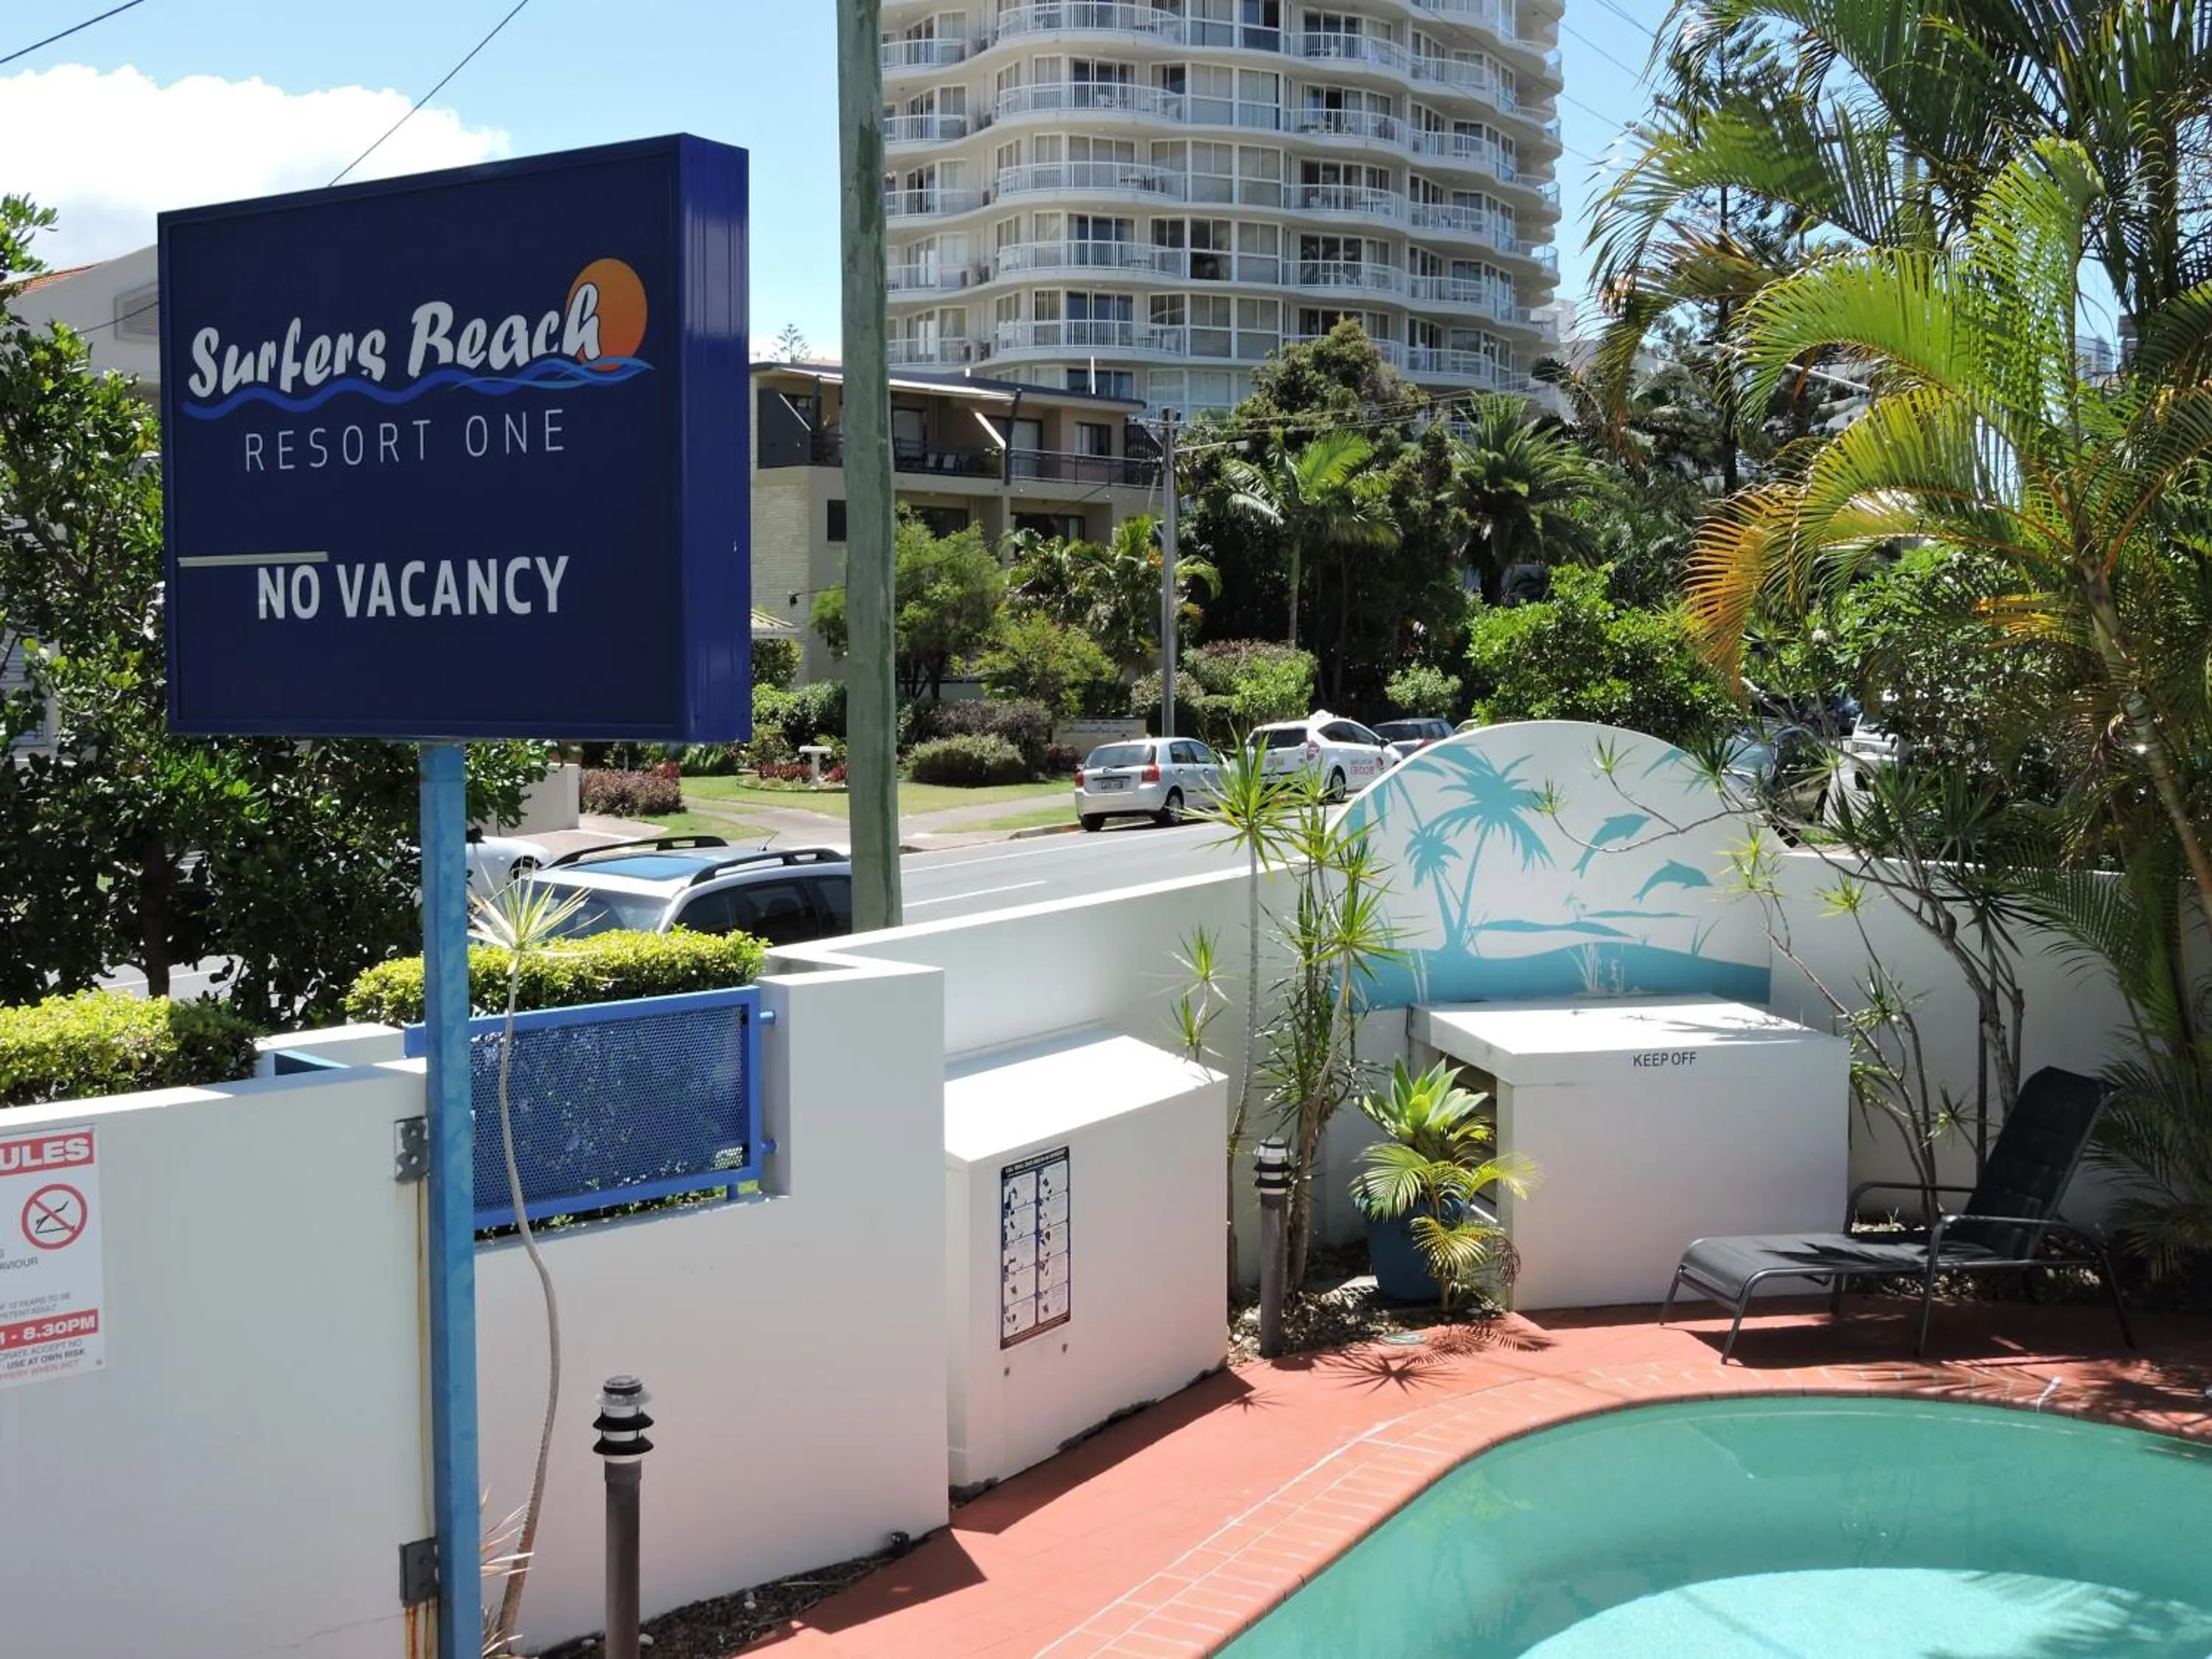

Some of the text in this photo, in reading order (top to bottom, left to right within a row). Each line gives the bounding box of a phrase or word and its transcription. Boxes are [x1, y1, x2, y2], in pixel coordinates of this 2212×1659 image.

[188, 282, 602, 397] Surfers Reach
[246, 409, 565, 472] RESORT ONE
[258, 555, 569, 619] NO VACANCY
[1632, 1051, 1697, 1068] KEEP OFF
[7, 1348, 86, 1370] USE AT OWN RISK
